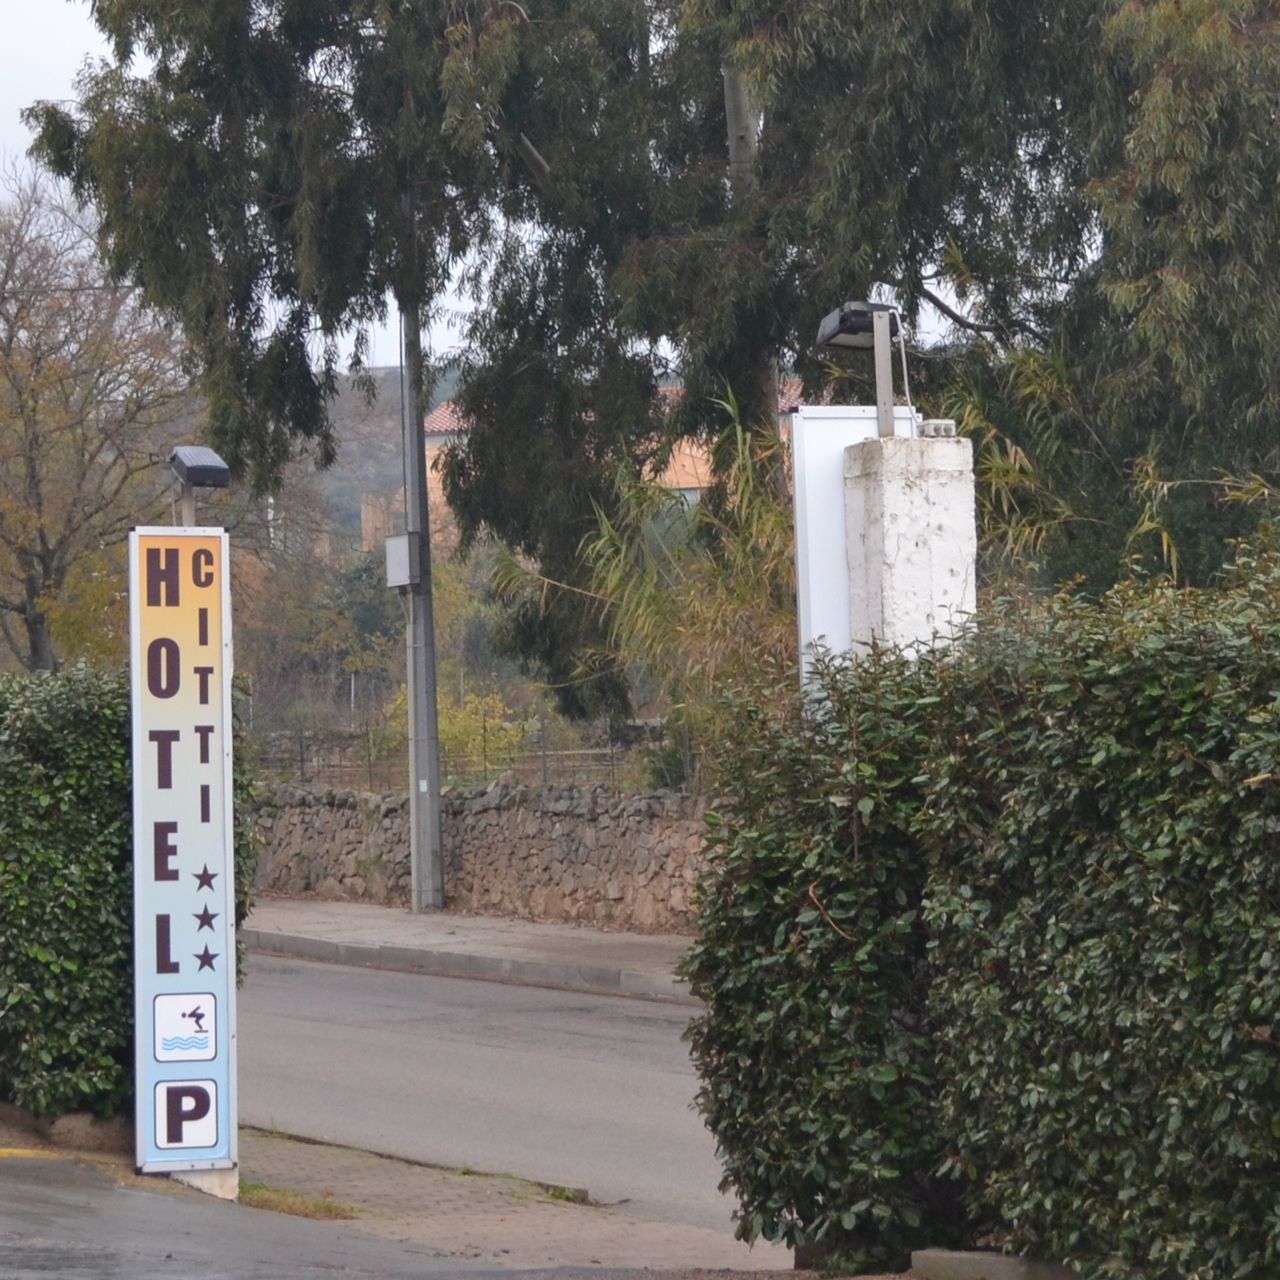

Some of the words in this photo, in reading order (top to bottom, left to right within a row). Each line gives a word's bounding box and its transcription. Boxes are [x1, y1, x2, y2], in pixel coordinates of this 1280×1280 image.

[147, 548, 180, 973] HOTEL
[192, 549, 214, 823] CITTI
[166, 1085, 211, 1144] P
